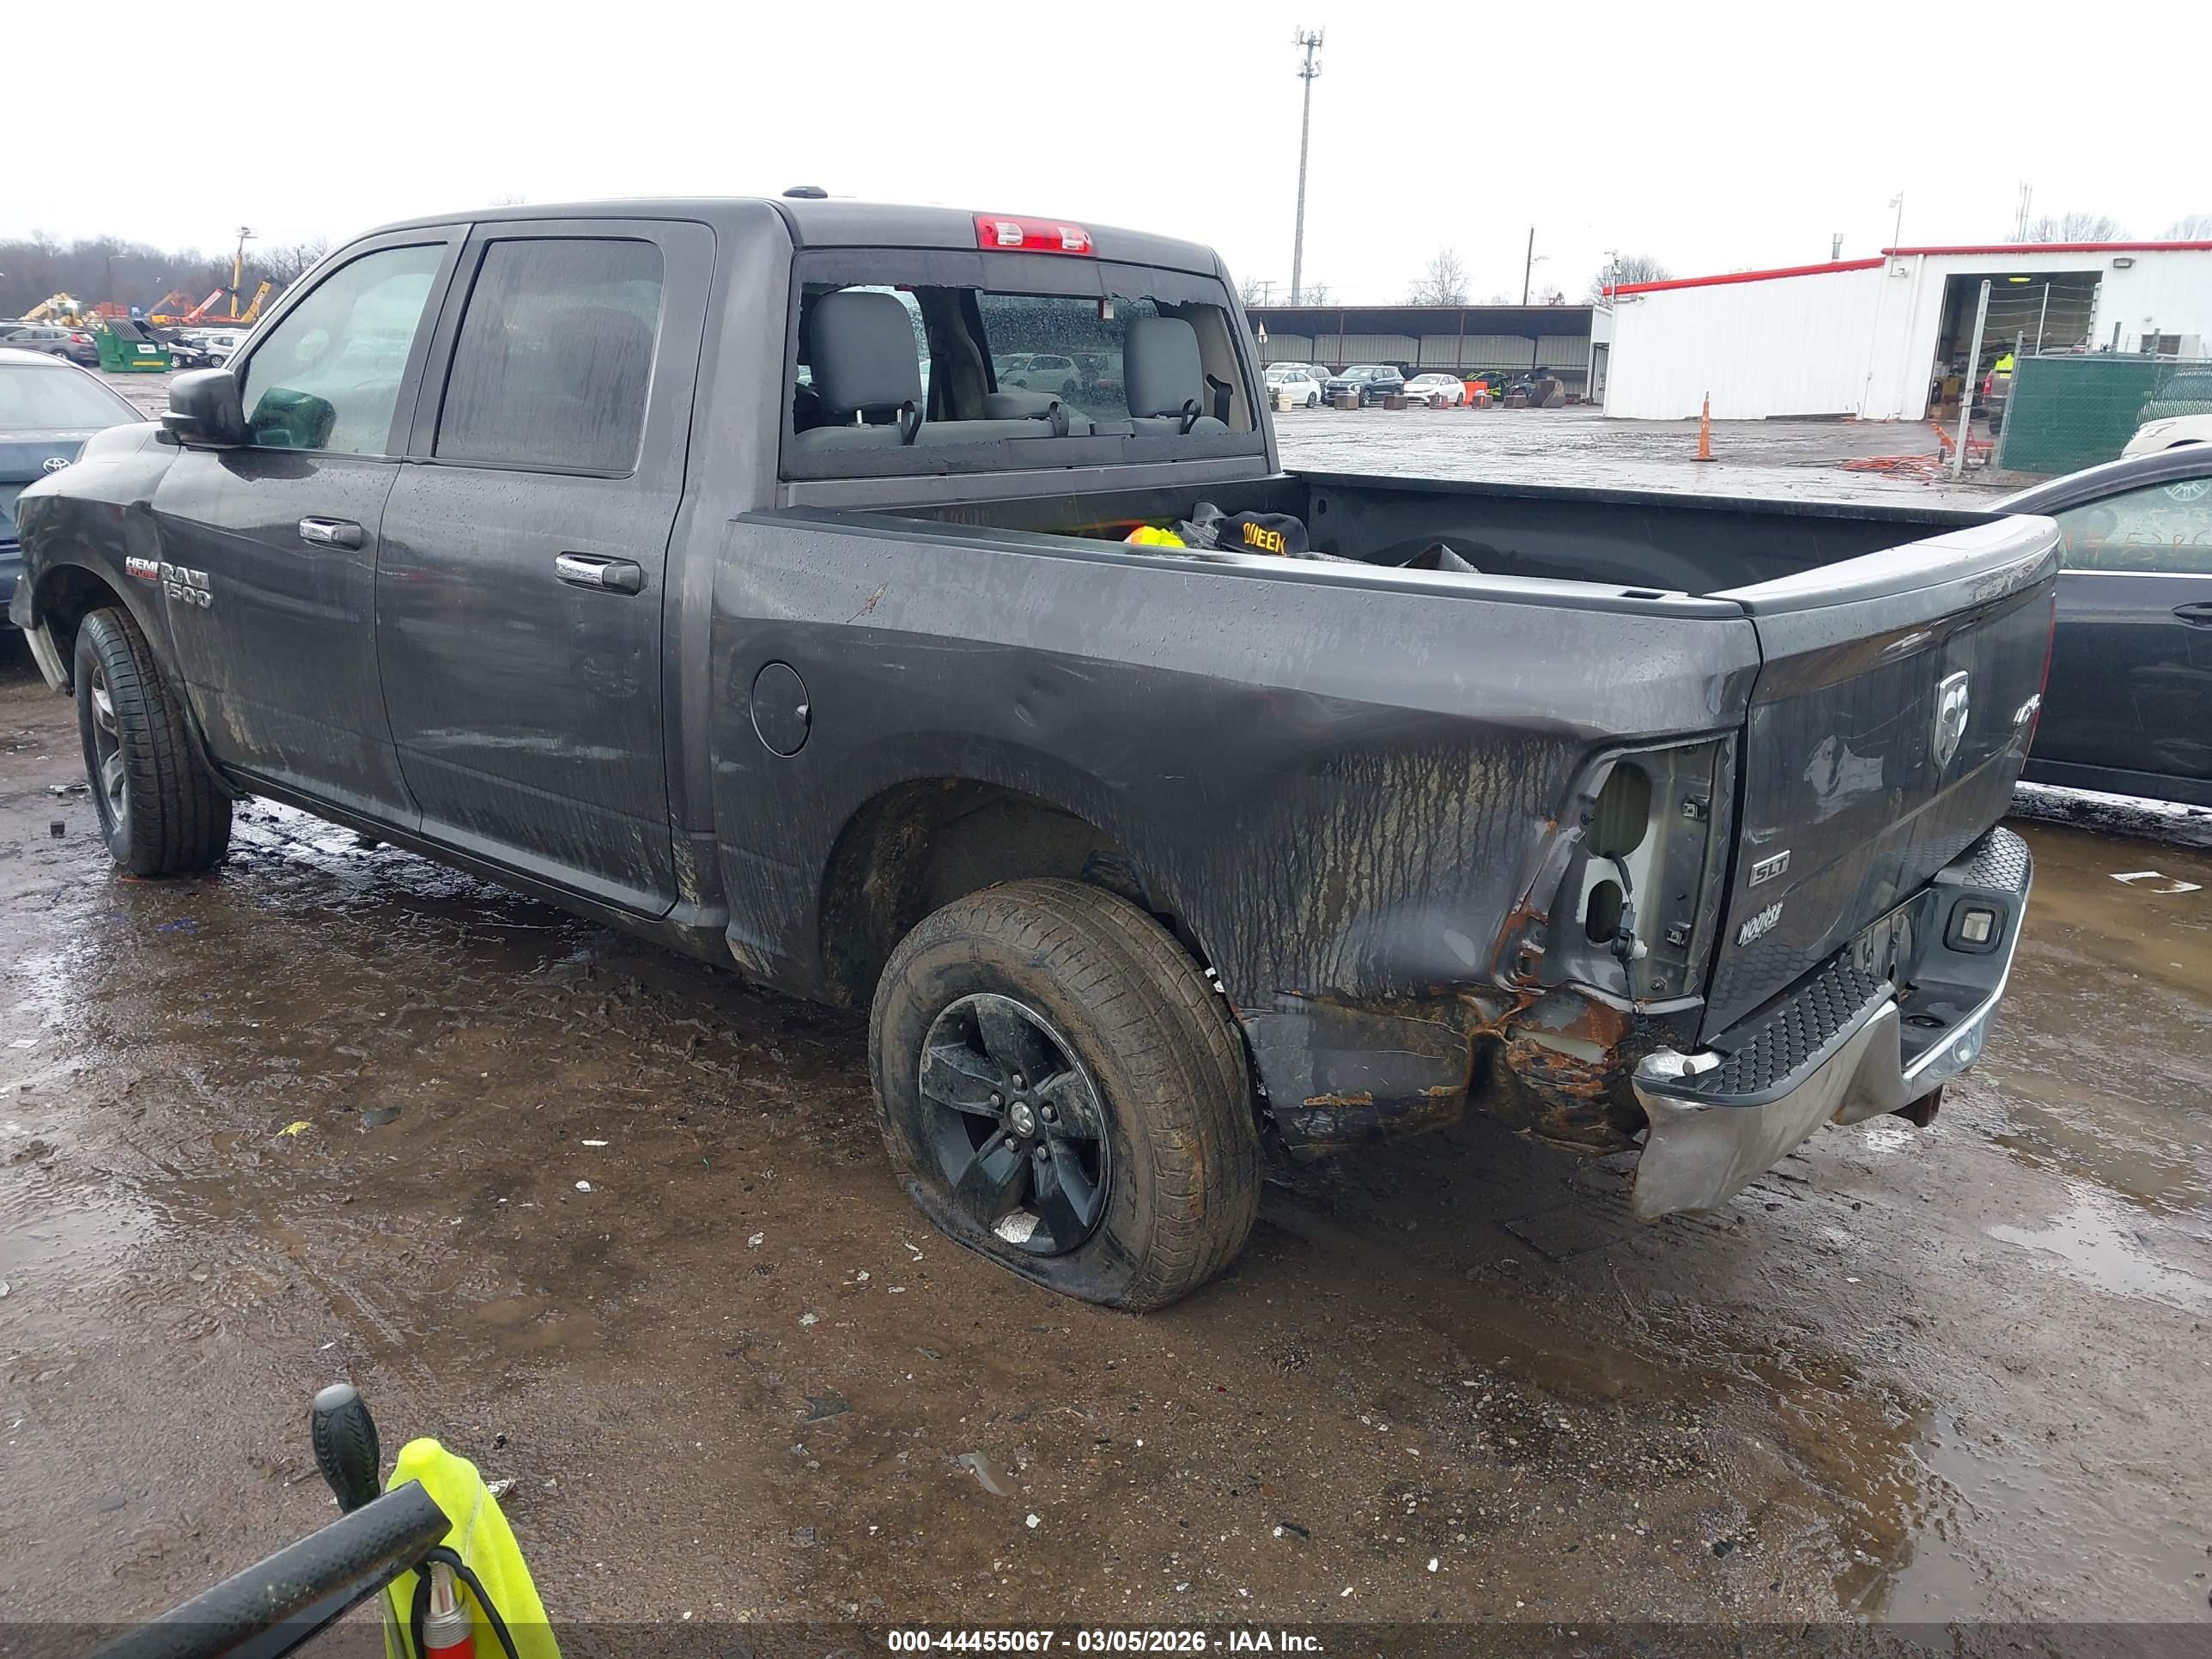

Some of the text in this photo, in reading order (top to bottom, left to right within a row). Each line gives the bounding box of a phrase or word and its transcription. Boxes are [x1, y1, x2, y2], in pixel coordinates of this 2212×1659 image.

[1243, 521, 1286, 556] QUEEN
[125, 556, 159, 571] HEMI
[162, 580, 213, 609] 1500
[1753, 855, 1788, 882] SLT
